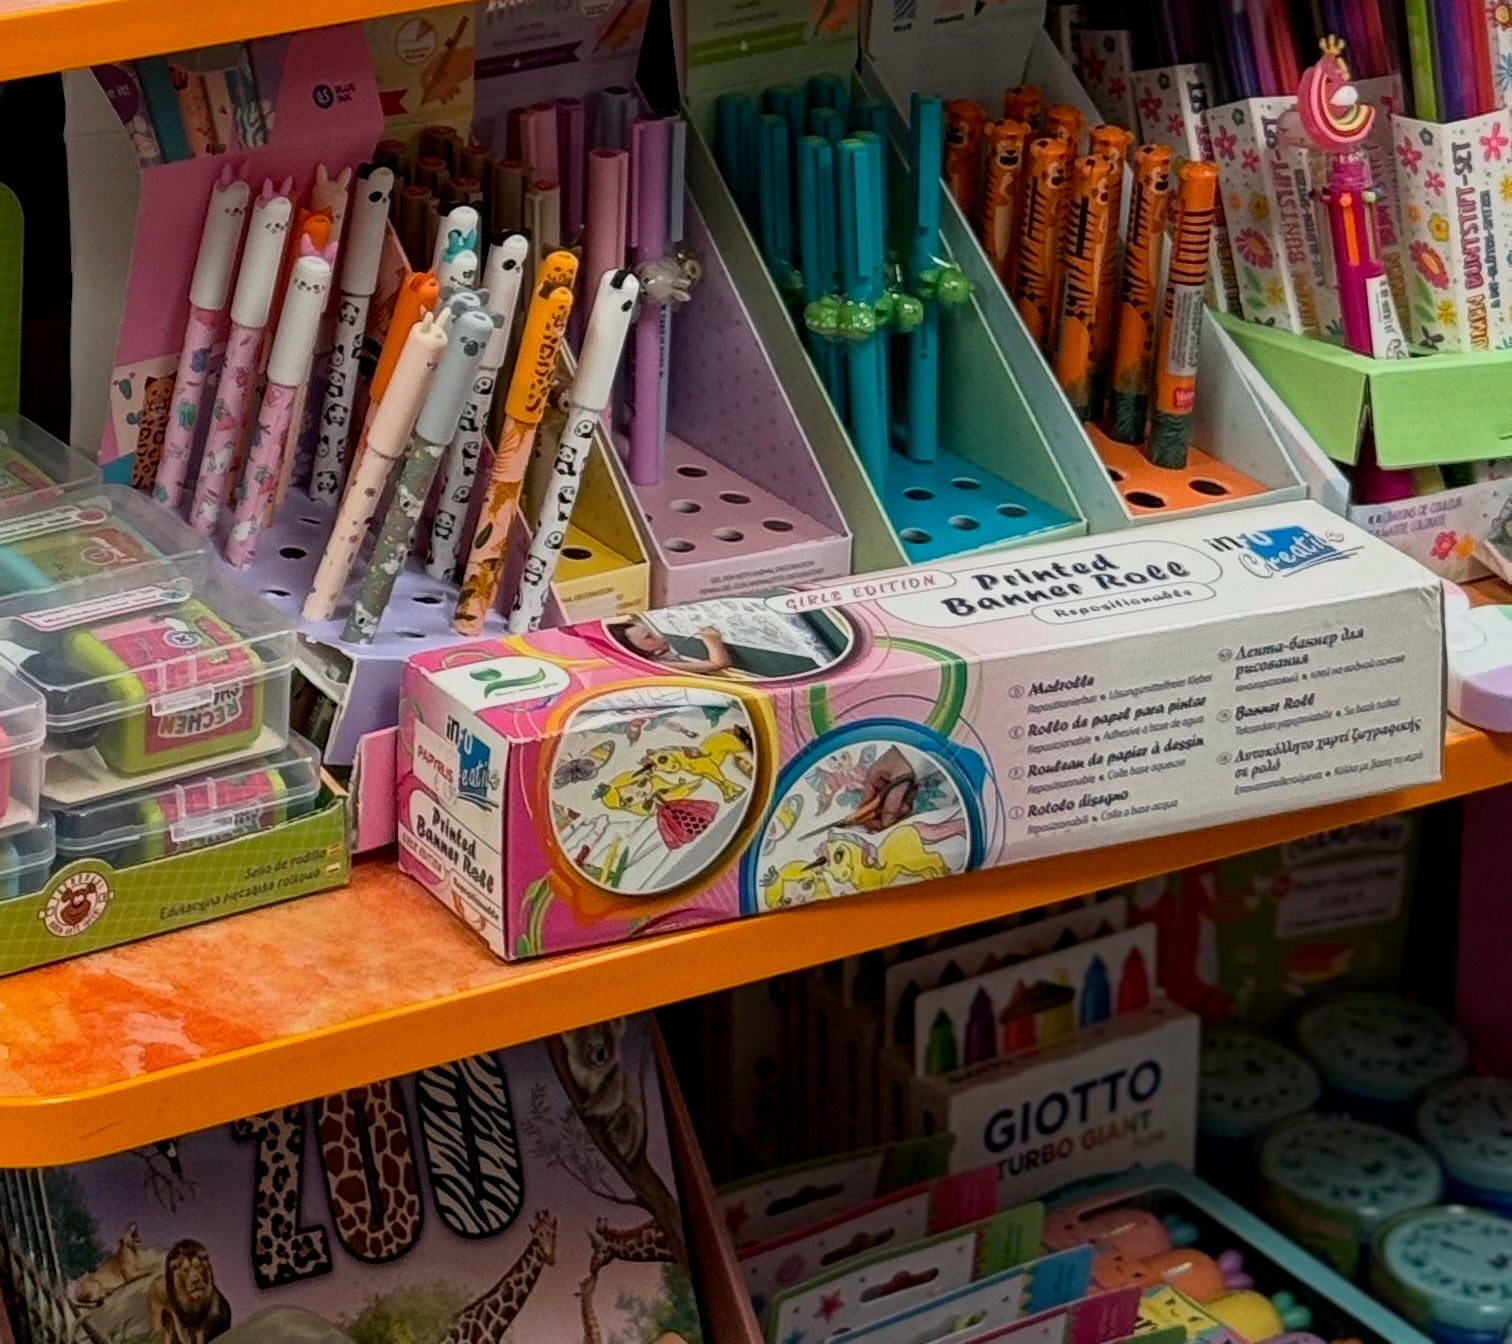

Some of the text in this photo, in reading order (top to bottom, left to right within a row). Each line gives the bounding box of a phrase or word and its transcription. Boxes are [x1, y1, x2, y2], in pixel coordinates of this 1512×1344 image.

[851, 572, 937, 600] EDITION
[972, 551, 1119, 591] Printed
[942, 578, 1082, 617] Banner
[1052, 587, 1194, 621] Repositionable
[416, 814, 460, 866] Banner
[432, 806, 478, 861] Printed
[983, 1058, 1164, 1156] GIOTTO
[230, 1050, 526, 1291] ZOO
[995, 1110, 1154, 1183] TURBO GIANT
